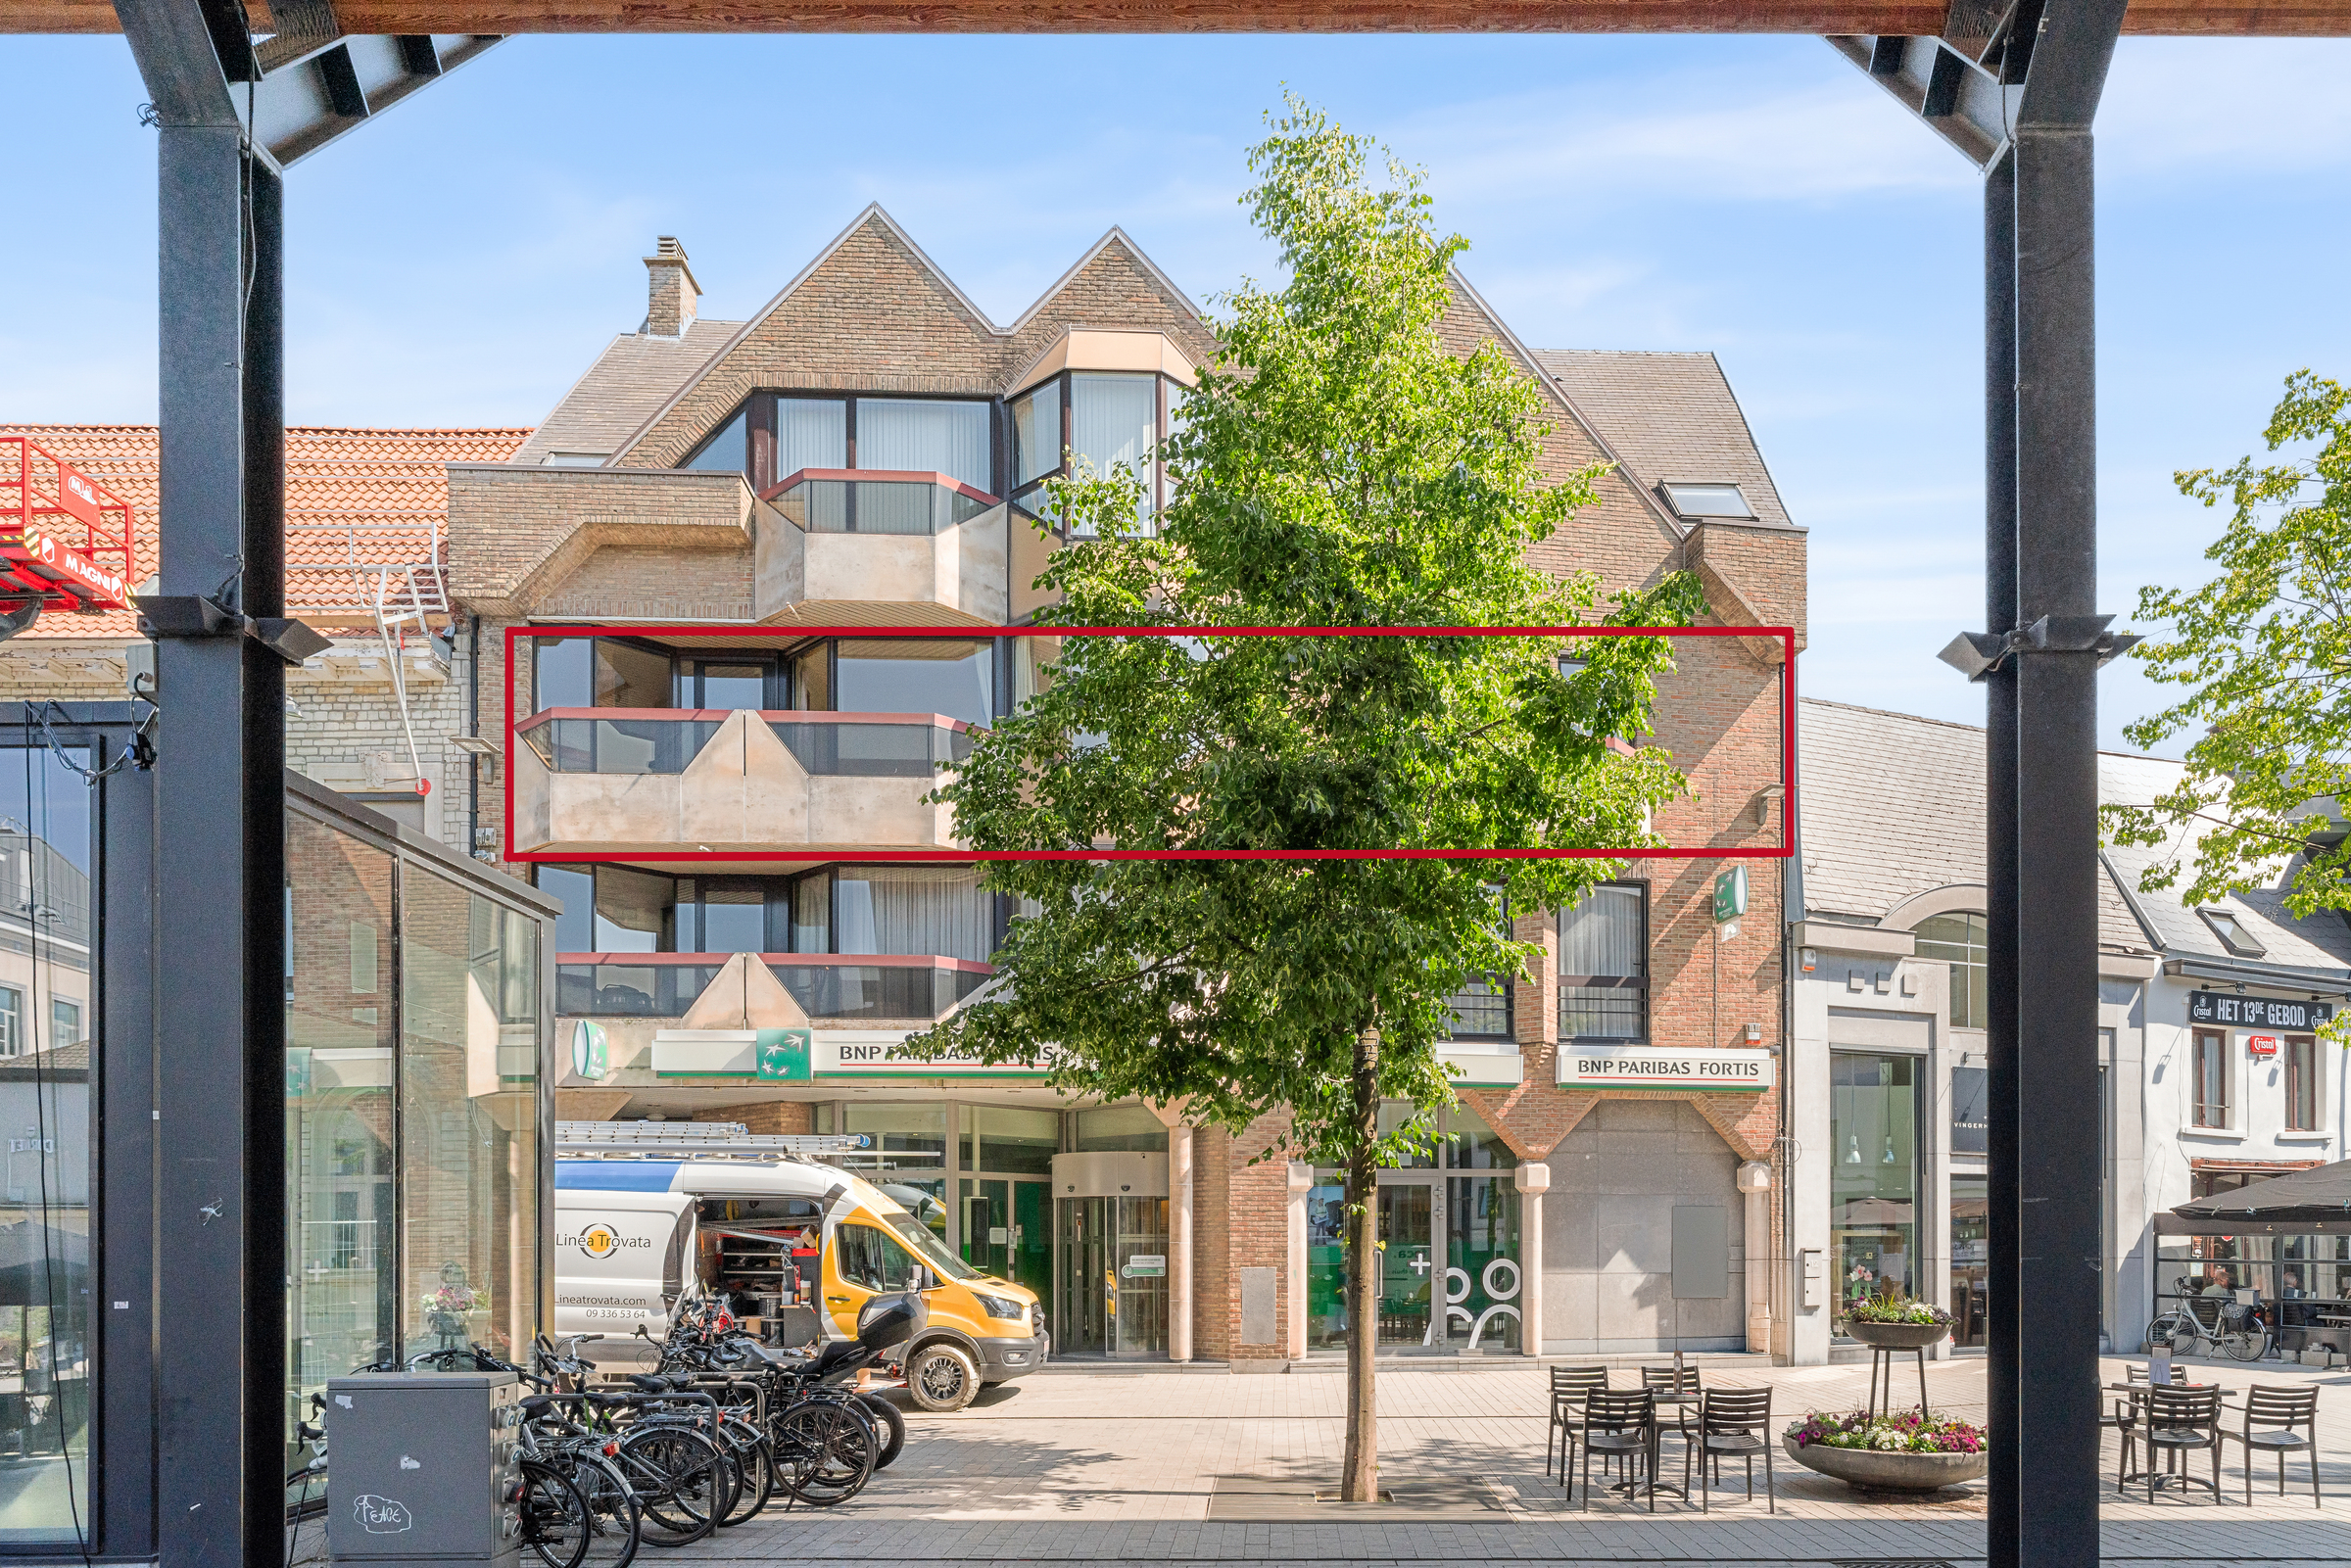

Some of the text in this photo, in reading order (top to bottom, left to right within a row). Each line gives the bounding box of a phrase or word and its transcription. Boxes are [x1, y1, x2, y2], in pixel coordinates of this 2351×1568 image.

[65, 553, 111, 592] MAGNI
[2193, 1005, 2212, 1018] Cristal
[2217, 998, 2240, 1022] HET
[2267, 1003, 2306, 1026] GEBOD
[2254, 1036, 2275, 1051] Cristal
[840, 1046, 882, 1060] BNP
[1578, 1060, 1759, 1076] BNP PARIBAS FORTIS
[555, 1233, 651, 1249] Linea Trovata
[586, 1309, 599, 1318] 09
[600, 1309, 618, 1318] 336
